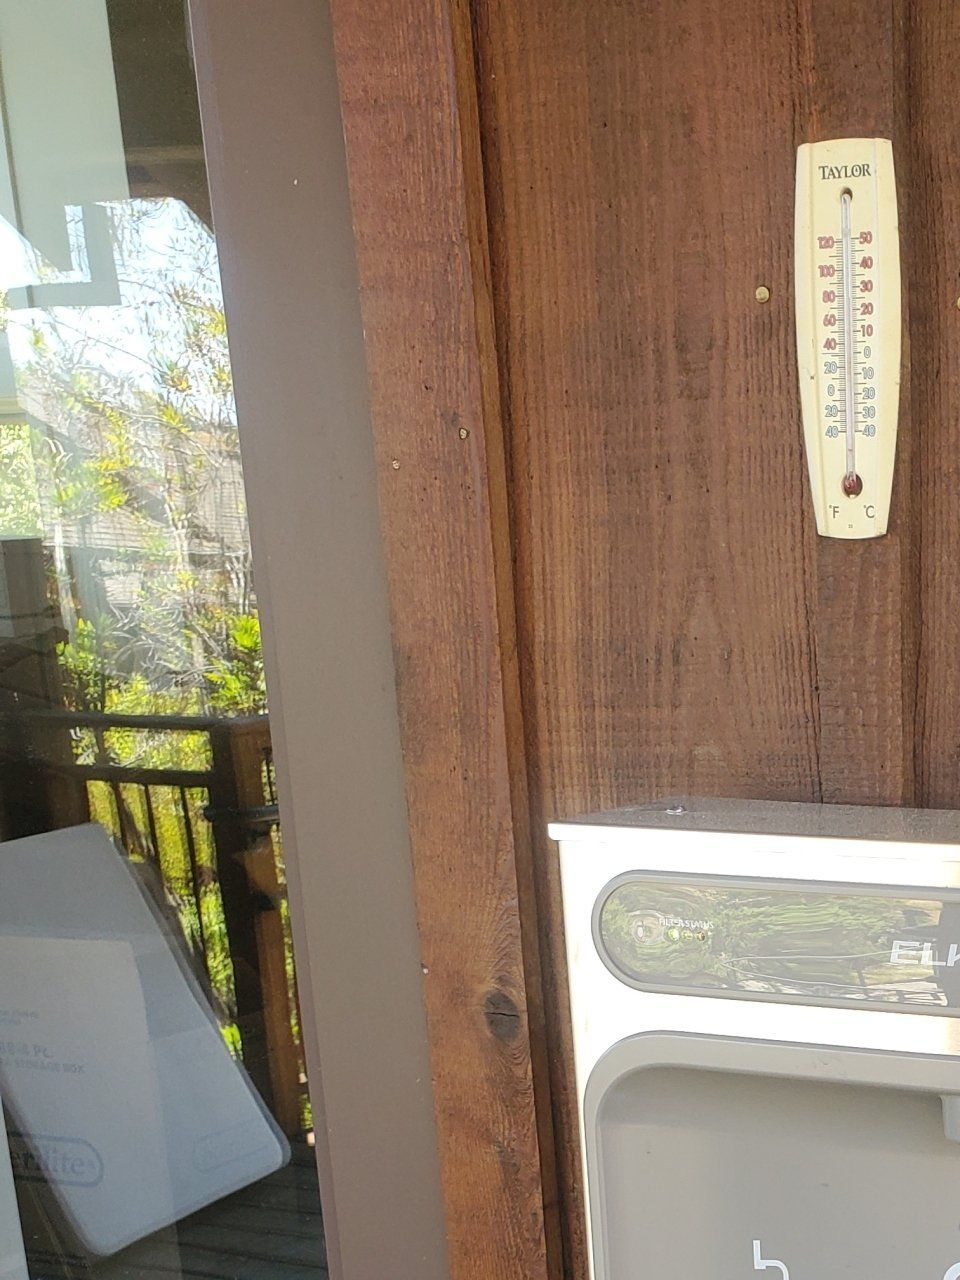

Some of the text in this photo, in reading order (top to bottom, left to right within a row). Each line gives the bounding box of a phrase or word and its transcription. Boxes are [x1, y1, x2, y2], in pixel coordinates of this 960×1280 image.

[818, 163, 871, 180] TAYLOR
[817, 236, 834, 249] 120
[859, 231, 873, 244] 50
[860, 256, 873, 269] 40
[818, 264, 835, 277] 100
[860, 280, 873, 293] 30
[822, 290, 836, 303] 80
[860, 303, 873, 316] 20
[823, 314, 836, 327] 60
[861, 324, 873, 337] 10
[823, 338, 836, 350] 40
[863, 346, 872, 358] 0
[824, 361, 837, 374] 20
[862, 367, 874, 379] 10
[827, 384, 835, 396] 0
[862, 387, 875, 399] 20
[825, 405, 838, 417] 20
[862, 406, 875, 418] 30
[825, 426, 838, 438] 40
[862, 425, 875, 437] 40
